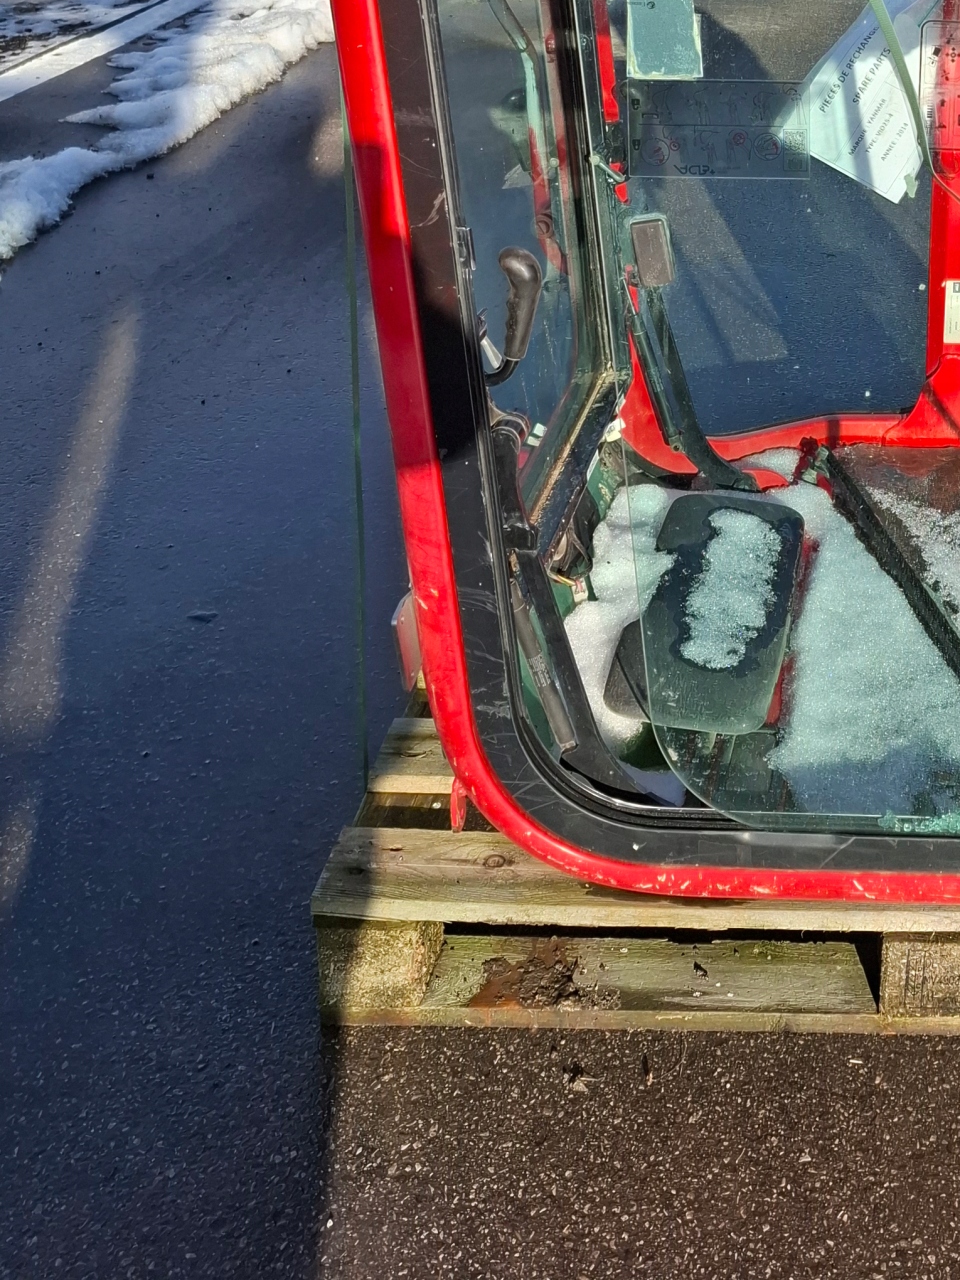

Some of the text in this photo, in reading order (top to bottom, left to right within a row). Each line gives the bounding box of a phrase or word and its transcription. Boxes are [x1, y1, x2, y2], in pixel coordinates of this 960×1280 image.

[819, 26, 880, 114] PIECES DE RECHANGE
[852, 47, 891, 105] SPARE PARTS
[848, 129, 867, 156] MARQUE
[867, 98, 887, 124] YANMAR
